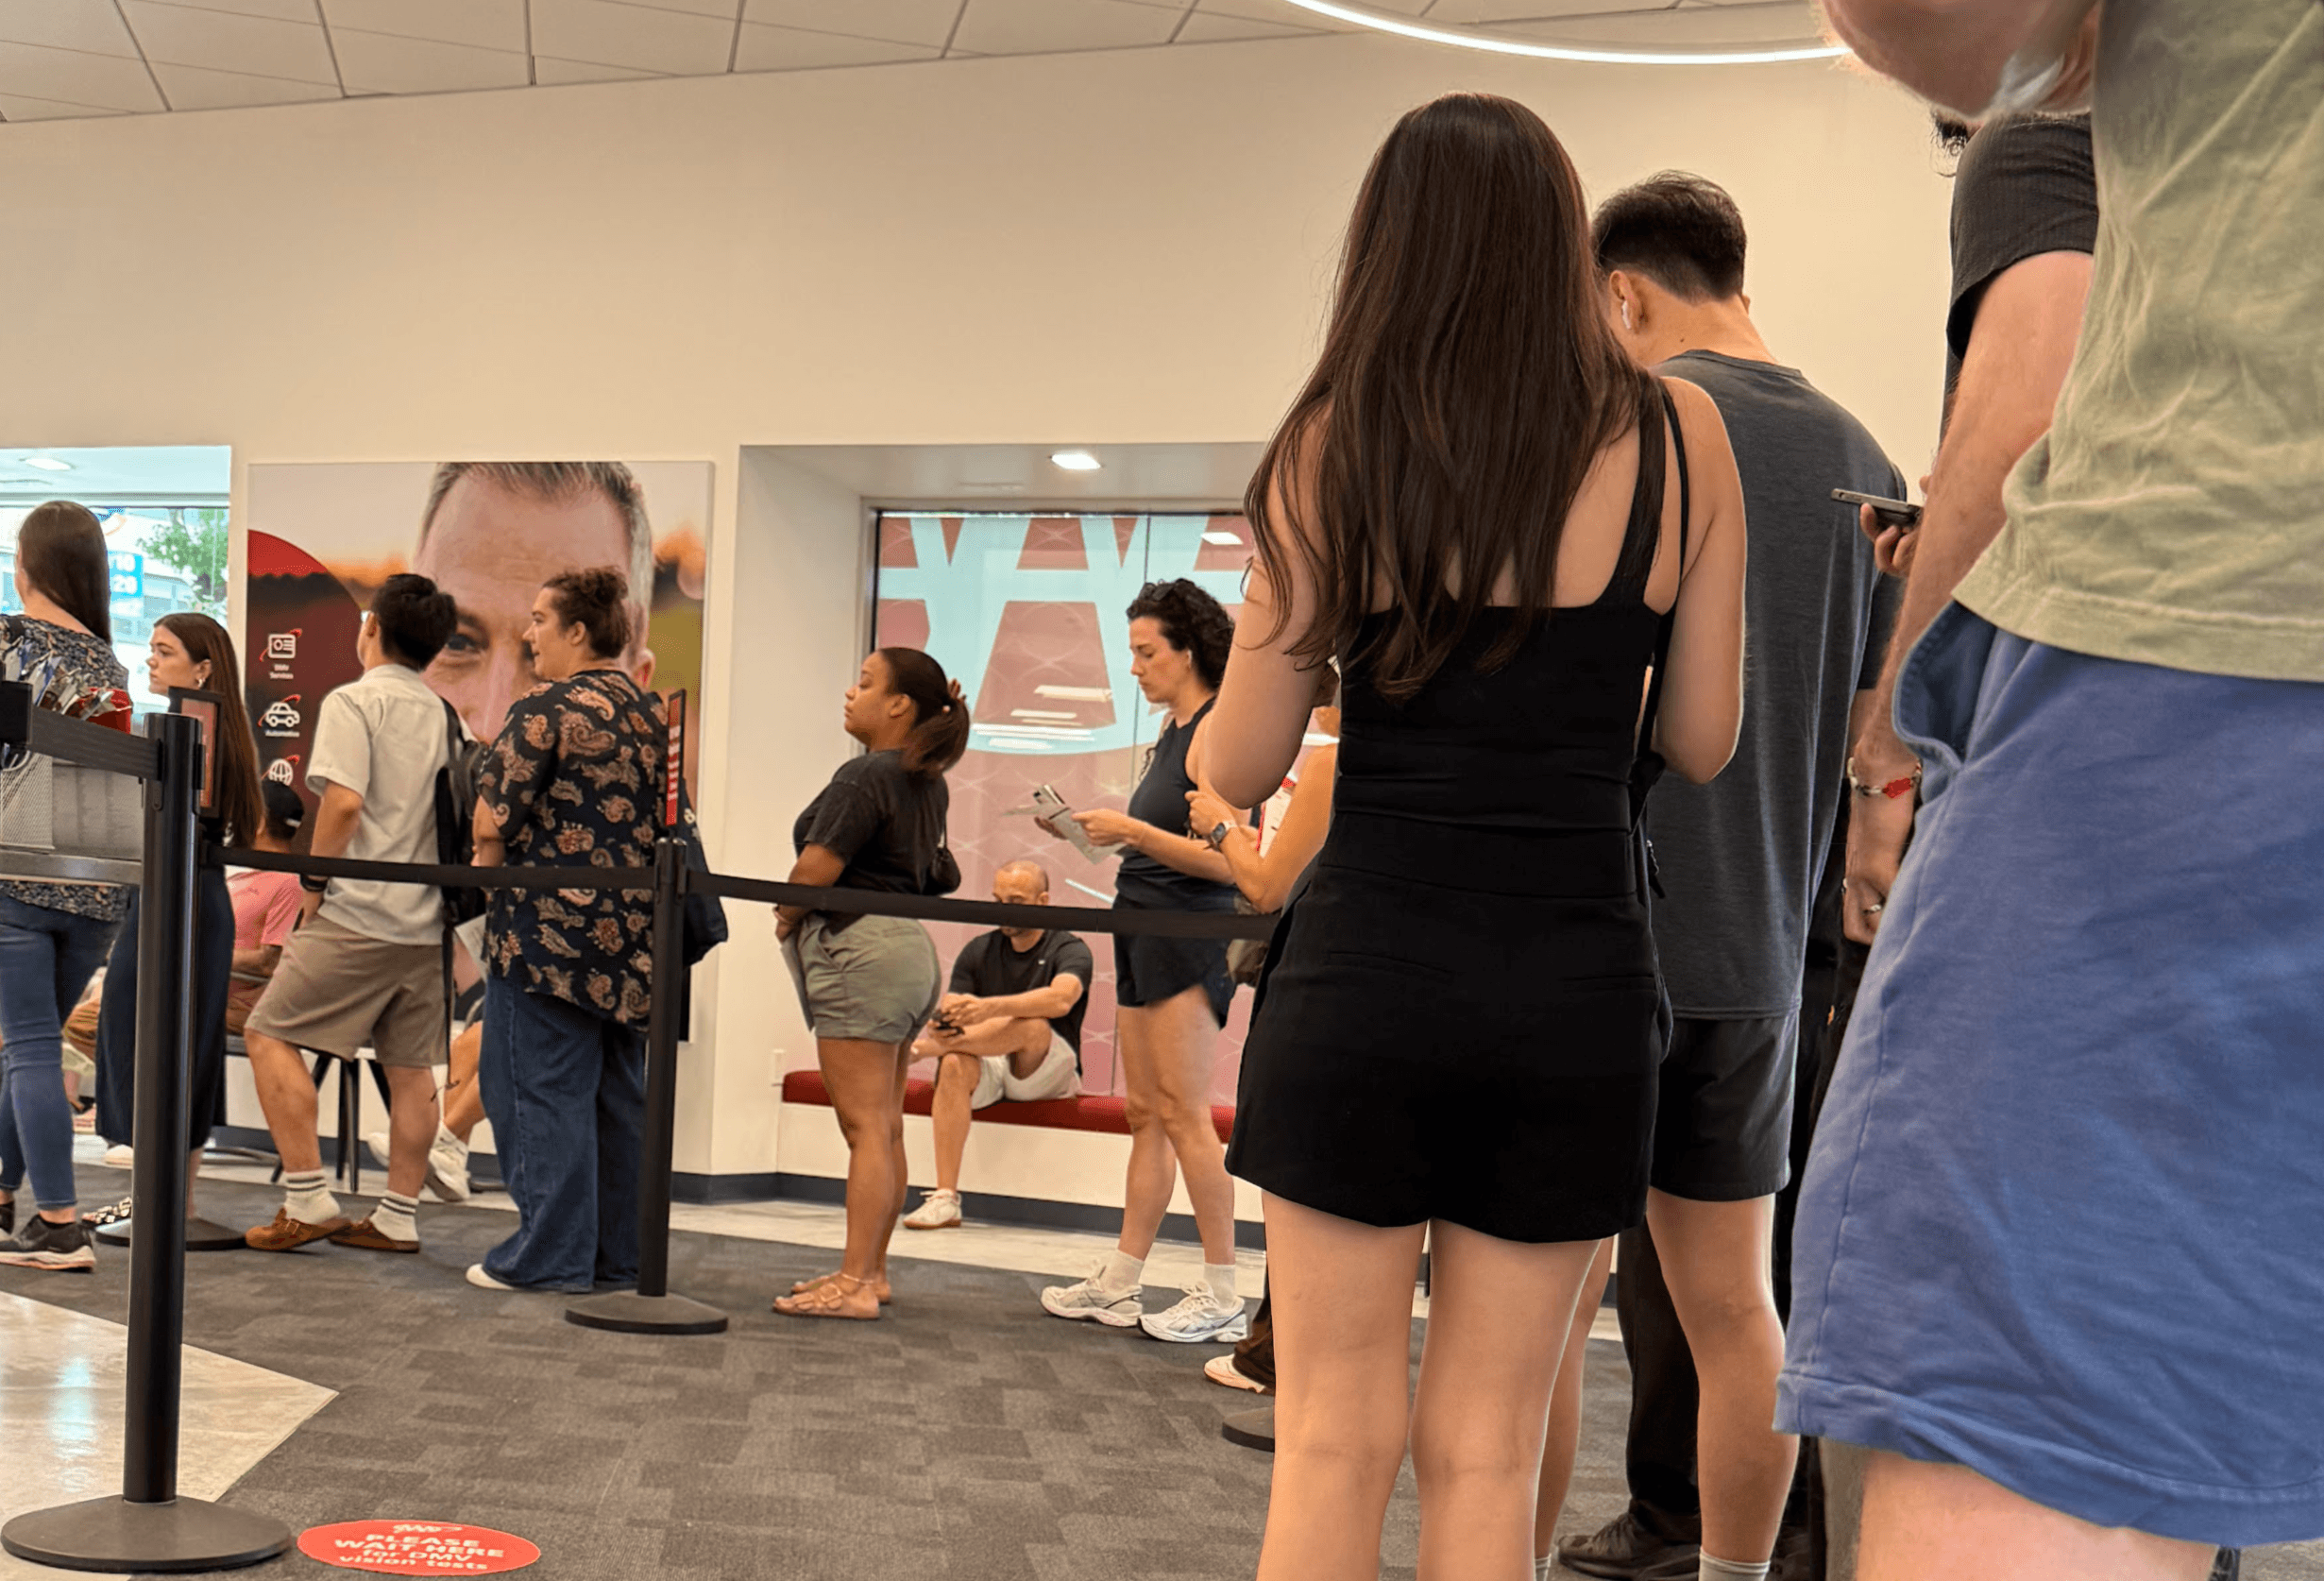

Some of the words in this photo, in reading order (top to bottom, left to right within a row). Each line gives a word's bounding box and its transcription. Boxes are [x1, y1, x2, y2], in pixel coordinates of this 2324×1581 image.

[365, 1535, 480, 1547] PLEASE
[335, 1539, 416, 1552] WAIT
[426, 1545, 504, 1557] HERE
[363, 1549, 400, 1557] for
[409, 1552, 471, 1561] DMV
[339, 1556, 416, 1565] vision
[426, 1559, 488, 1570] tests
